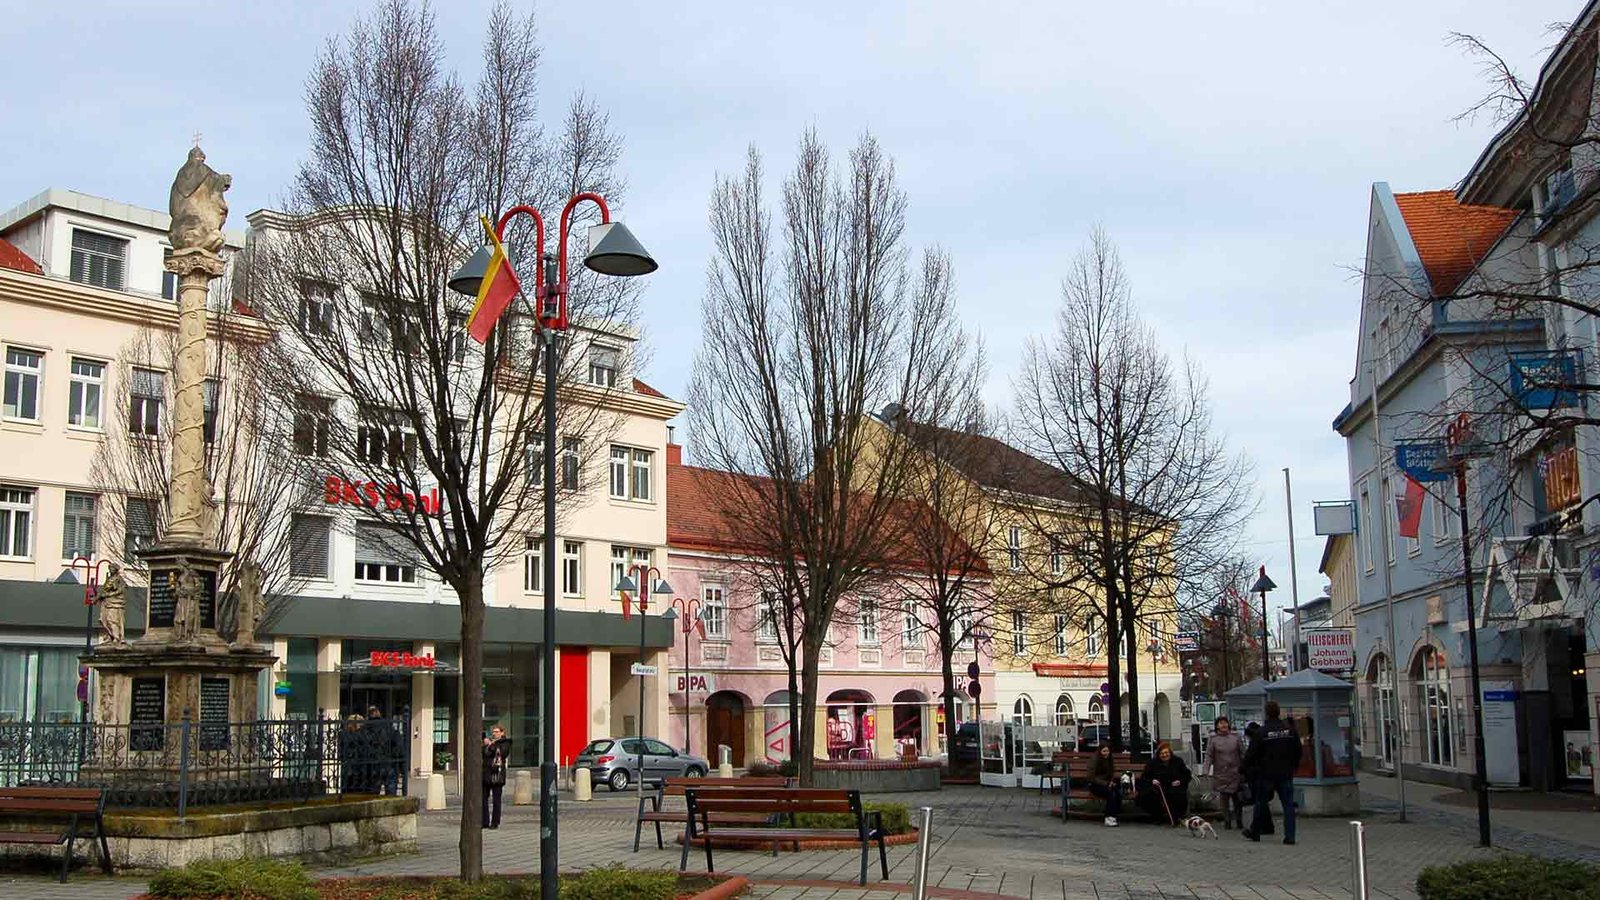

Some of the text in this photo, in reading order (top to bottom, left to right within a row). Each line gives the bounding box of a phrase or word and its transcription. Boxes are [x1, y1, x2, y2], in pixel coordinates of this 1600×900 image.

[1313, 649, 1348, 657] Johann
[370, 651, 436, 668] BKS Bank
[1310, 657, 1353, 667] Gebhardt
[677, 676, 707, 691] BPA
